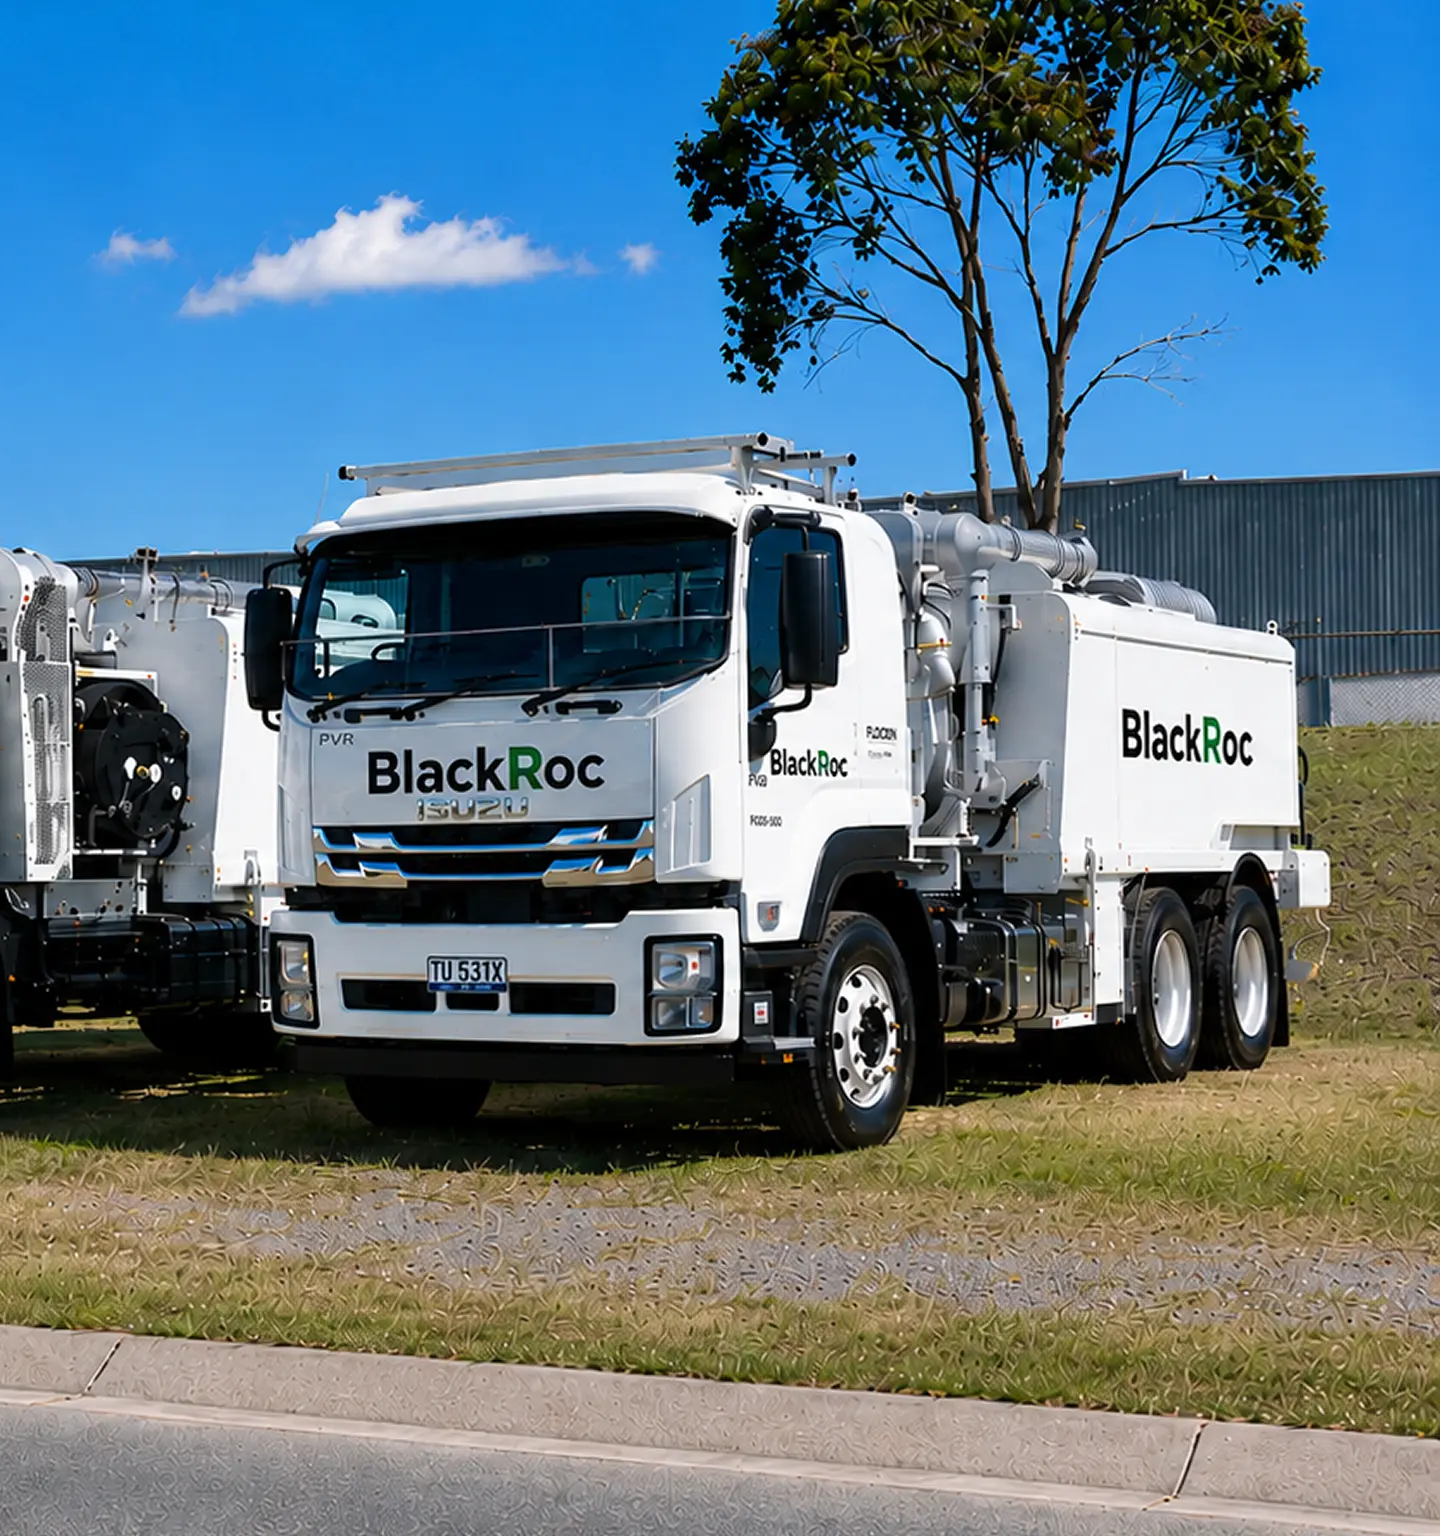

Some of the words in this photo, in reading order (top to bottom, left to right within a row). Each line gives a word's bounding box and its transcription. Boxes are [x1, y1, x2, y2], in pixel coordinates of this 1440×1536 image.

[319, 733, 355, 746] PVR
[1121, 708, 1254, 767] BlackRoc
[368, 746, 606, 795] BlackRoc
[770, 748, 848, 777] BlackRoc
[417, 797, 529, 821] ISUZU
[430, 960, 452, 981] TU
[458, 960, 503, 982] 531X
